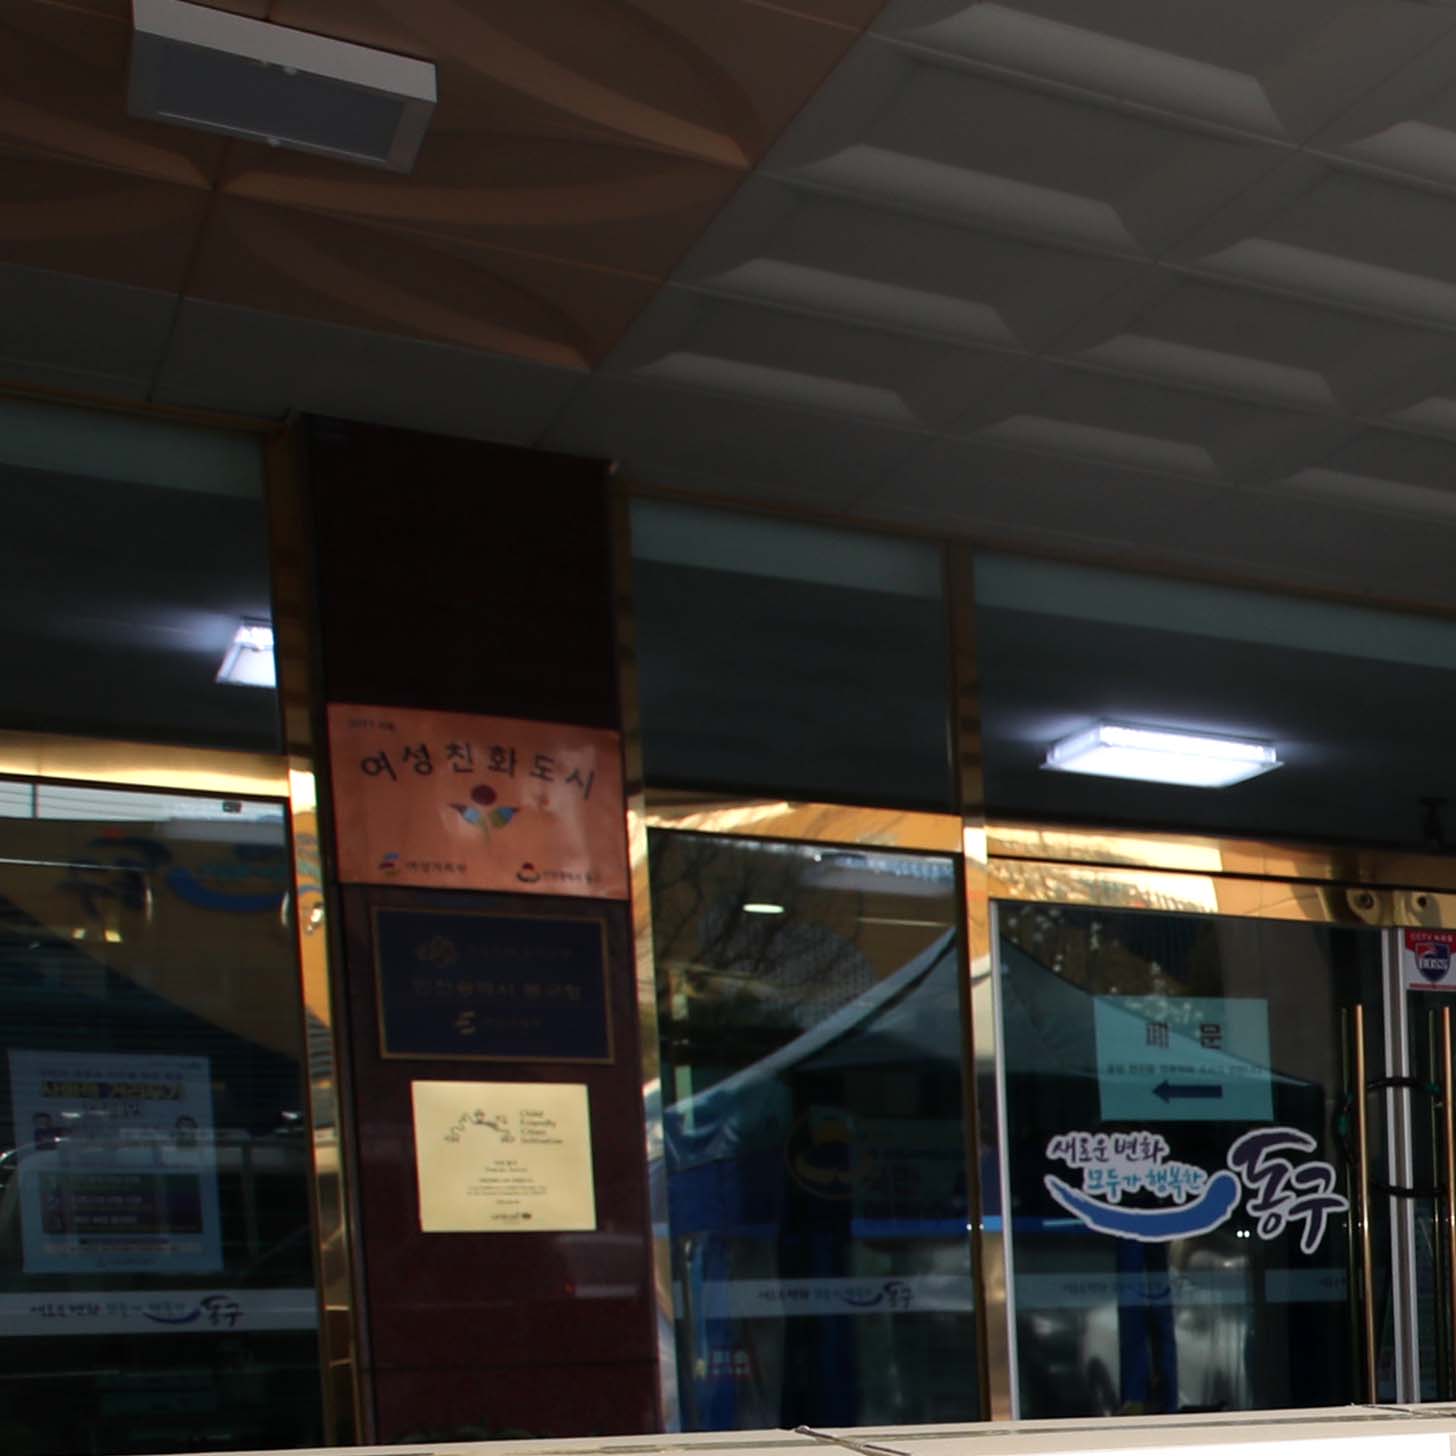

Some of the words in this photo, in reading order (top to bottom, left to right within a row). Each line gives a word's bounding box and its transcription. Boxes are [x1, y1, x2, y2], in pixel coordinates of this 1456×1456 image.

[1050, 1136, 1109, 1163] 새로운
[1114, 1134, 1165, 1163] 변화
[1086, 1168, 1141, 1197] 모두가
[1145, 1165, 1203, 1197] 행복한
[1231, 1130, 1347, 1252] 동구
